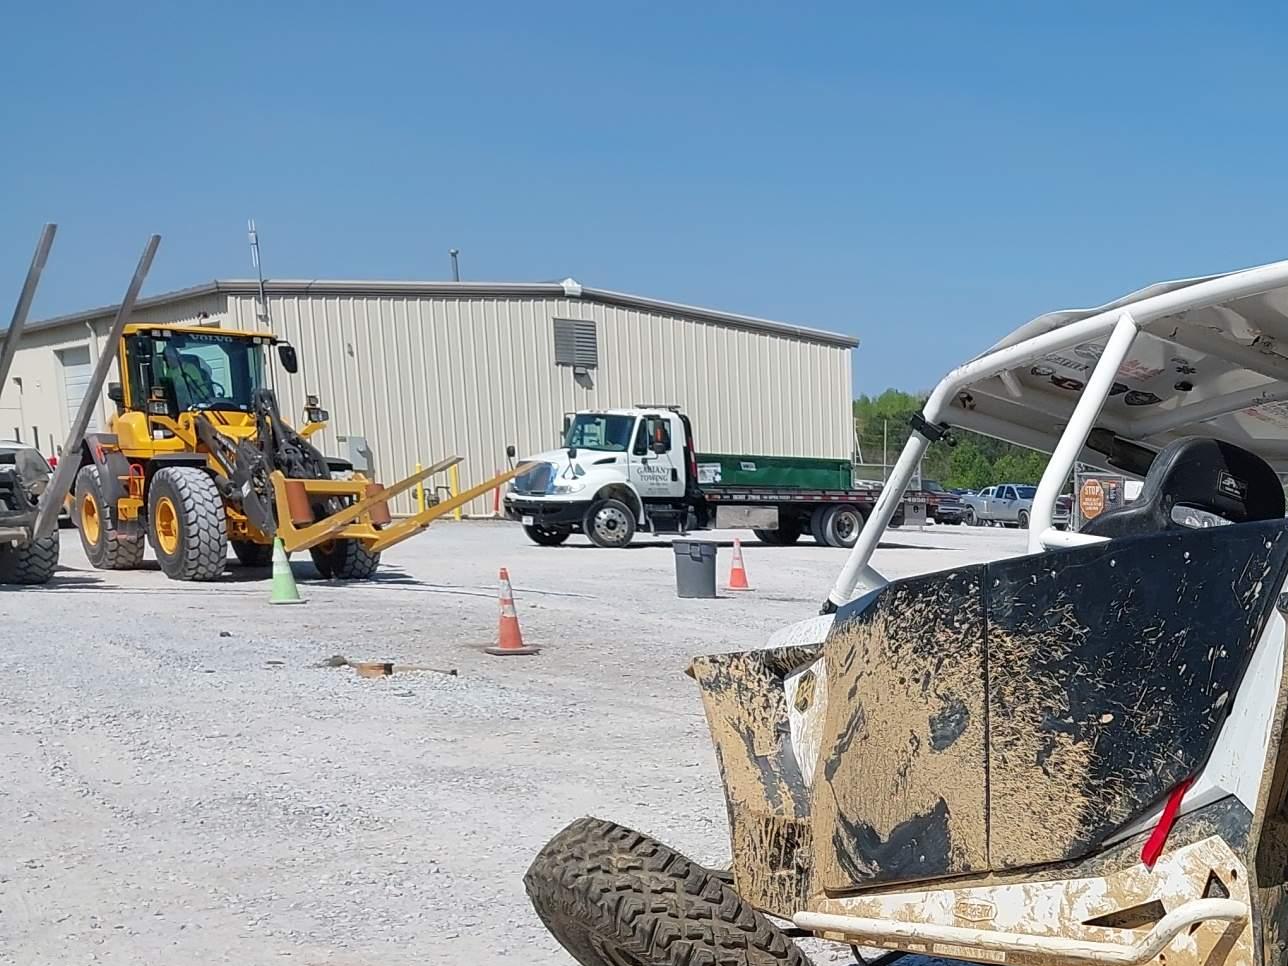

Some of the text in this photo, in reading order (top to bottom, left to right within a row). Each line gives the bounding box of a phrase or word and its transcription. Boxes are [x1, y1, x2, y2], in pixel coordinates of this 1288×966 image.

[189, 334, 233, 342] VOLVO
[640, 474, 668, 482] TOWING
[1084, 485, 1100, 496] STOP
